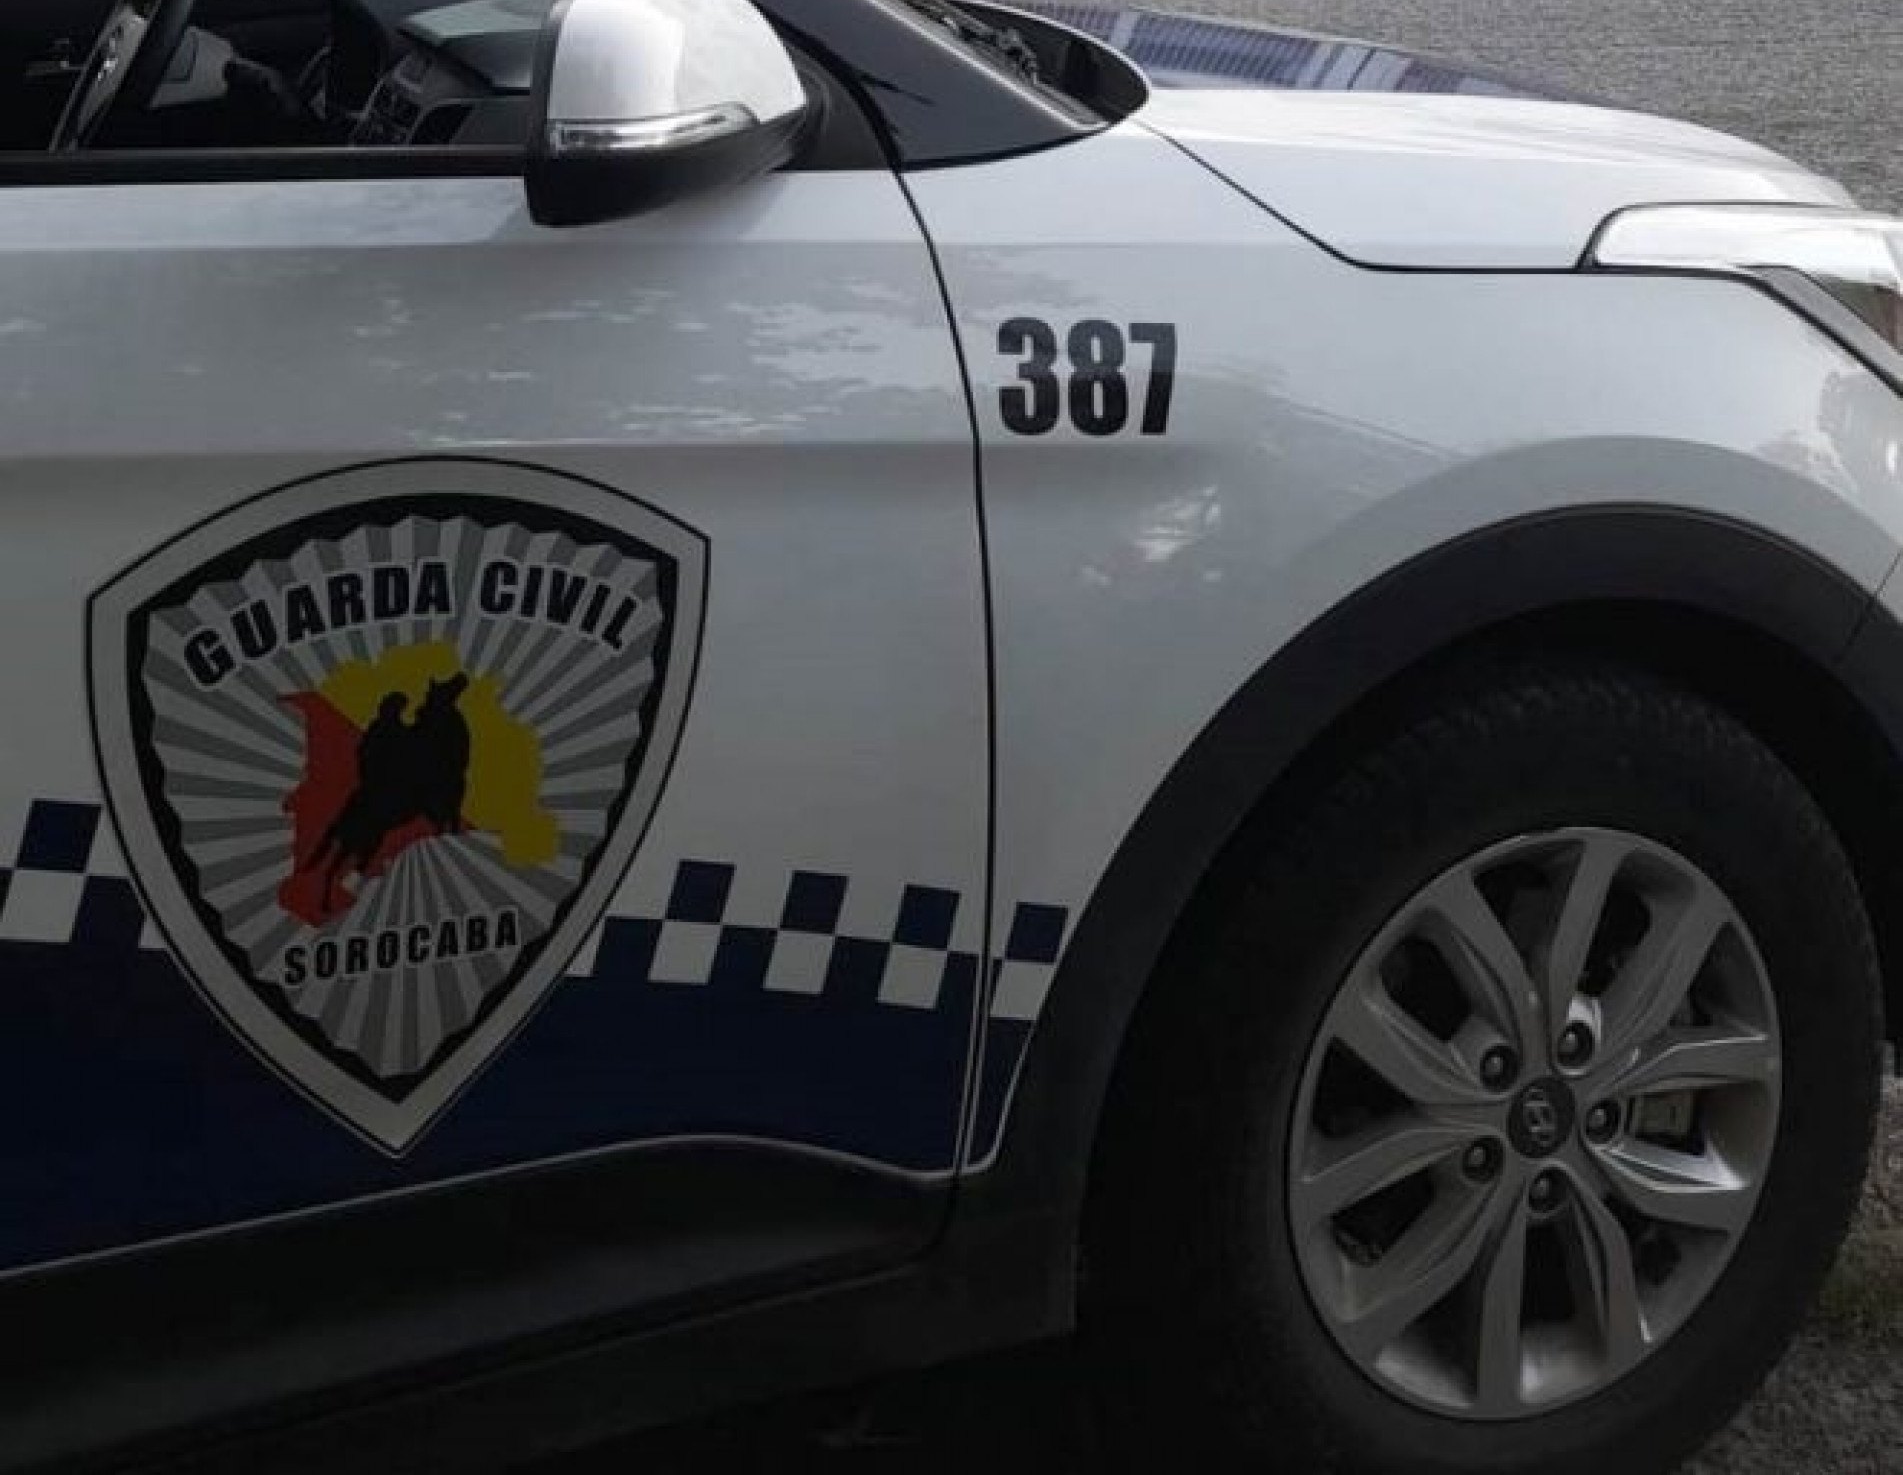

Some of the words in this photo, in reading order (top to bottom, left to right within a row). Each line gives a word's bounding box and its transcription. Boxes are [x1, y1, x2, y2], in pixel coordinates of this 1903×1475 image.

[997, 317, 1177, 436] 387
[183, 561, 452, 686] GUARDA
[480, 561, 637, 649] CIVIL
[284, 910, 517, 985] SOROCABA
